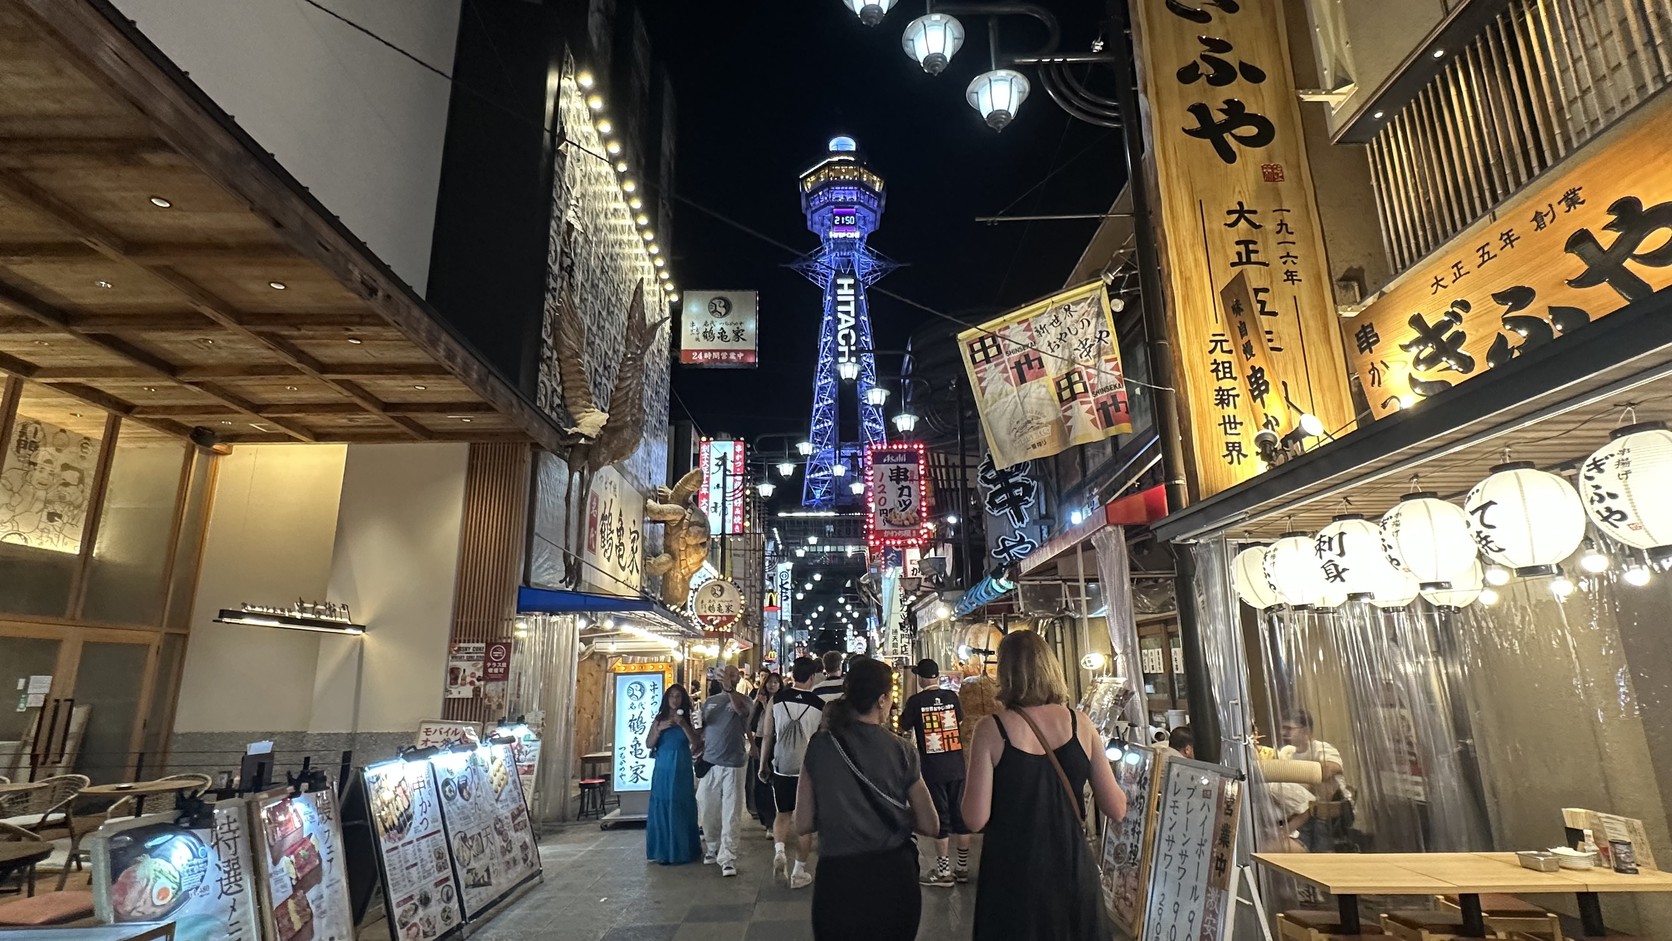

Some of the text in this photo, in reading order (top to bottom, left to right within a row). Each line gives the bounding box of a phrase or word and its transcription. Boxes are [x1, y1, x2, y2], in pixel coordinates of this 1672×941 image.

[1273, 209, 1303, 286] 一九一六年
[1430, 186, 1586, 296] 大正五年 創業
[702, 326, 747, 343] 鶴亀家
[837, 278, 857, 364] HITACH
[1033, 303, 1079, 339] 新世界
[1398, 195, 1672, 399] ぎふや
[691, 351, 745, 361] 24時間営業中
[1354, 321, 1406, 411] 串かつ
[1207, 333, 1249, 466] 元祖新世界
[1246, 364, 1281, 434] 串か
[882, 453, 907, 464] Asahi
[889, 465, 913, 513] 串カツ
[1583, 451, 1629, 529] ぎふや
[600, 498, 641, 577] 鶴亀家
[1314, 531, 1351, 584] 刺身
[422, 726, 460, 738] モバイル
[626, 710, 650, 785] 鶴亀家
[210, 814, 244, 941] 特選メニ
[1154, 785, 1181, 941] レモンサワー 290
